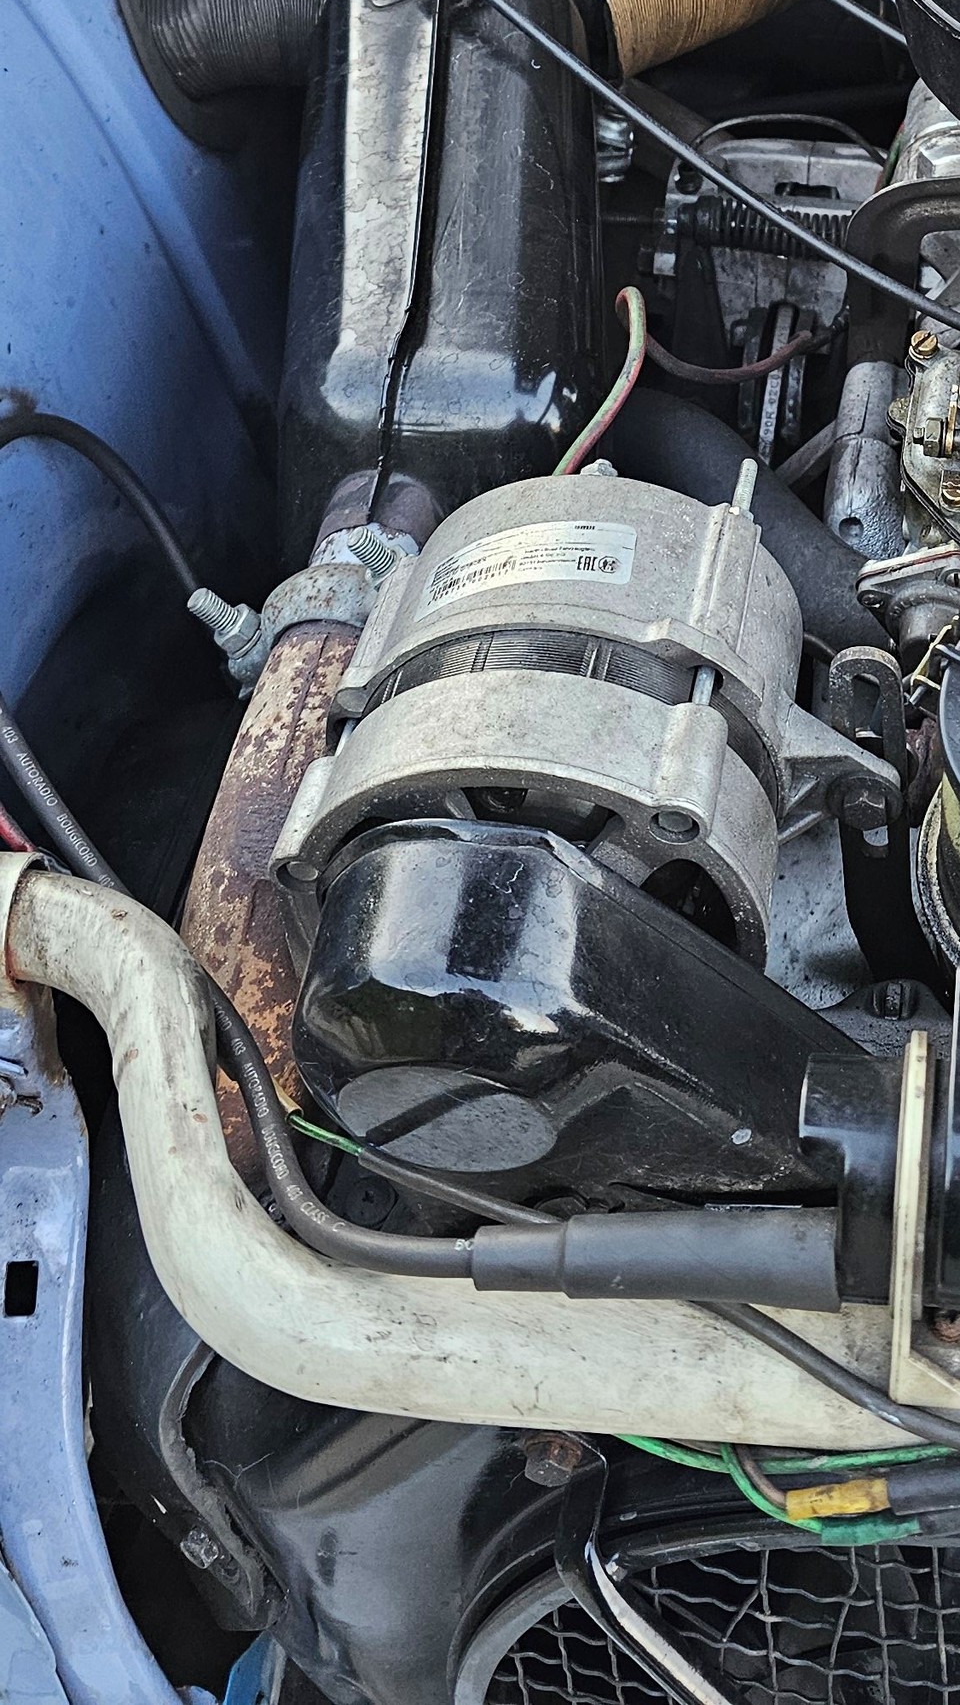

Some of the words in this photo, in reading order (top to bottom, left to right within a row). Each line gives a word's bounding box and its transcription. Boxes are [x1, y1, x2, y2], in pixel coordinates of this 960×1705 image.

[576, 555, 598, 571] EAC
[2, 726, 18, 745] 403
[16, 752, 58, 807] AUTORADIO
[56, 813, 98, 867] BOUGICORD
[230, 1037, 247, 1056] 403
[242, 1062, 270, 1118] AUTORADIO
[300, 1201, 330, 1225] CLASS
[332, 1222, 346, 1232] C
